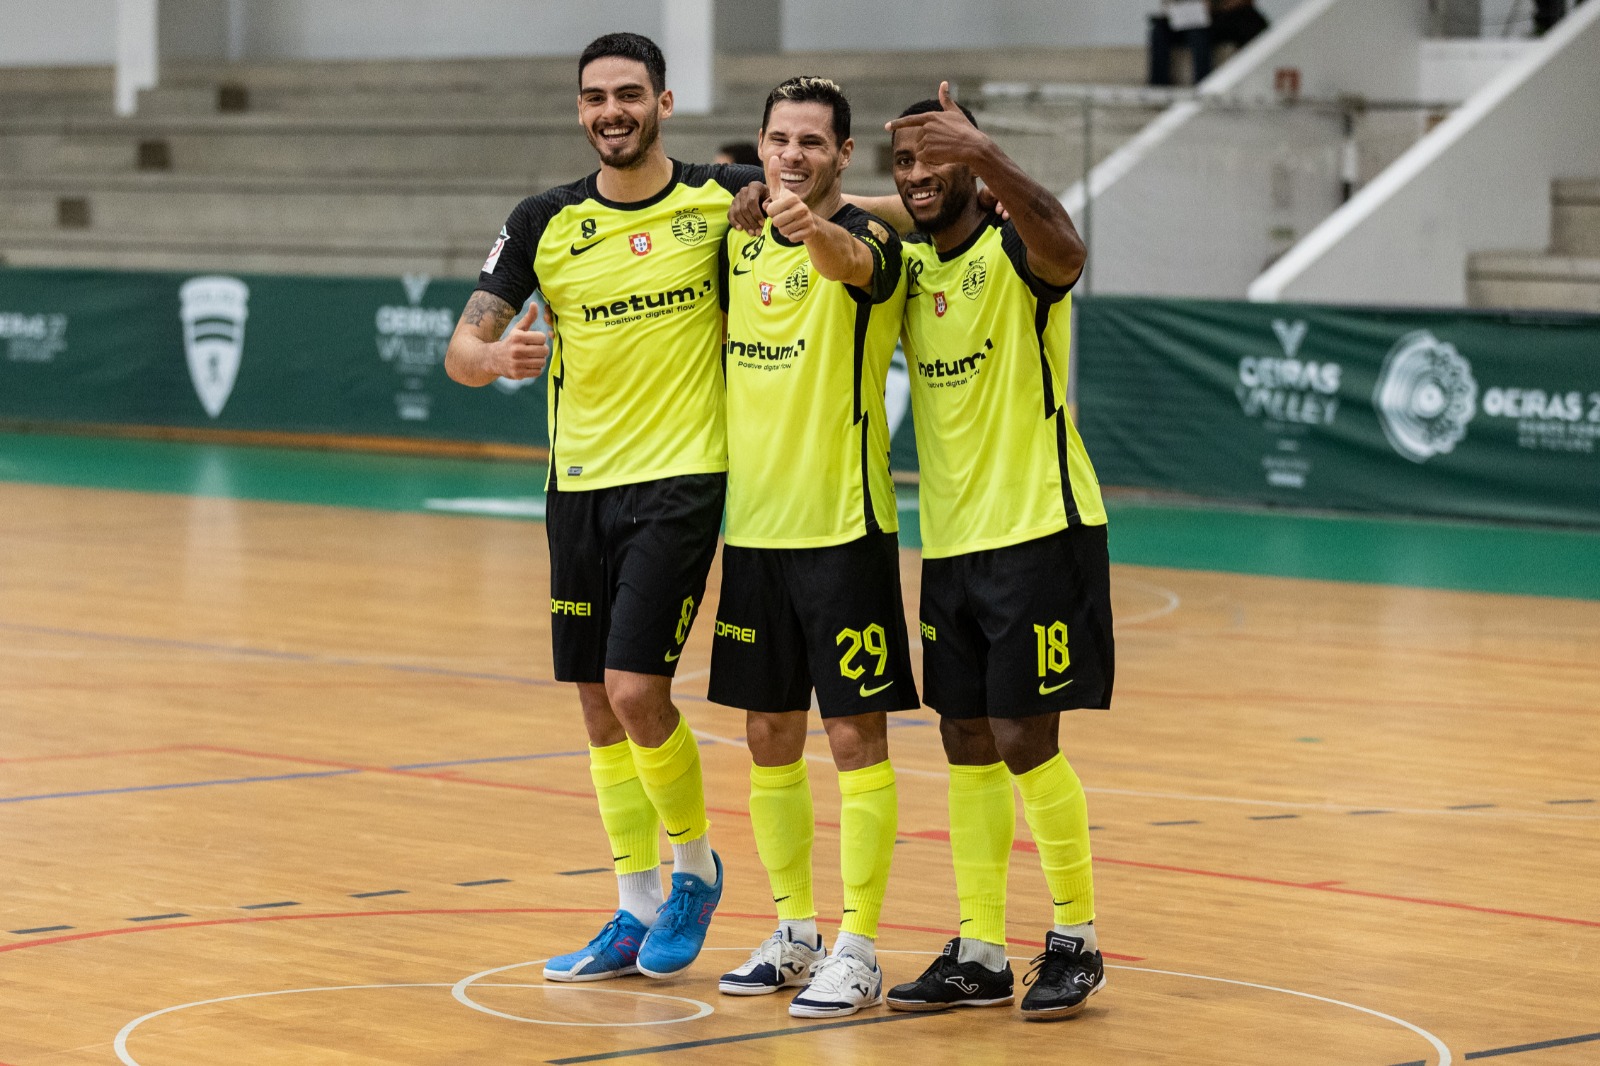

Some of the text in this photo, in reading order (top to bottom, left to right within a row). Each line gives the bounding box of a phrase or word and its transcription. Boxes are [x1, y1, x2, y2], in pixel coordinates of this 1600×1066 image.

[581, 218, 597, 239] 8
[605, 303, 696, 327] Positive digital flow
[675, 595, 695, 645] 8
[836, 623, 888, 680] 29
[1033, 620, 1071, 677] 18
